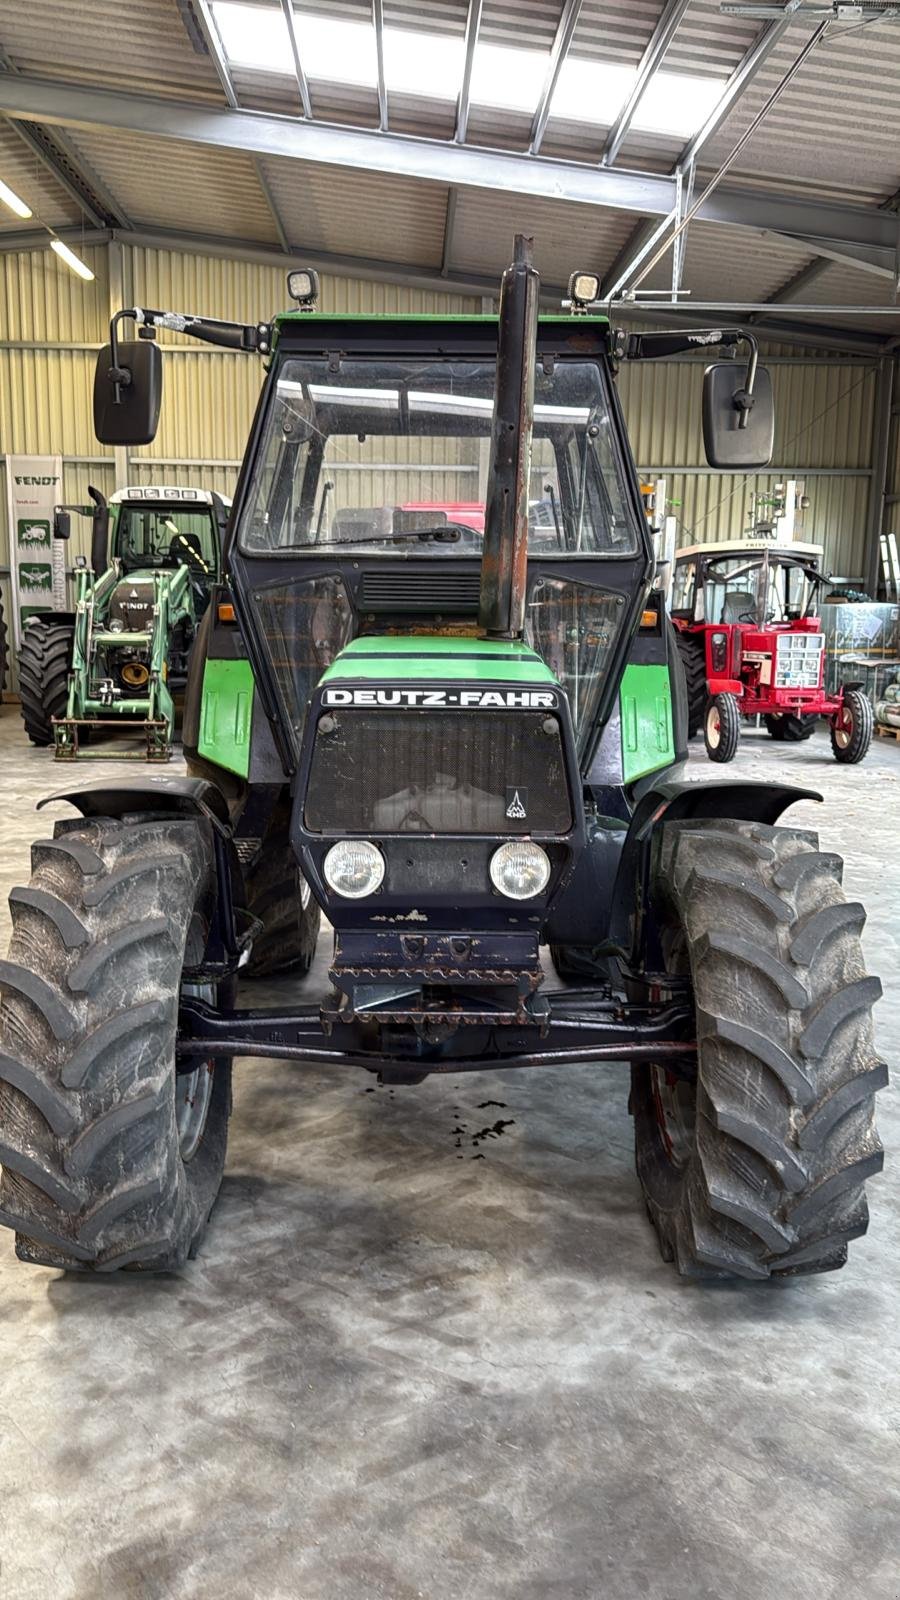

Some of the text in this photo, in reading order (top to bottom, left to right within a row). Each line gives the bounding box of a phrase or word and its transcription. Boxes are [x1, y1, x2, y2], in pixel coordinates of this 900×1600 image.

[14, 476, 60, 486] FENDT
[53, 540, 65, 576] SOLUTI
[327, 690, 554, 707] DEUTZ-FAHR
